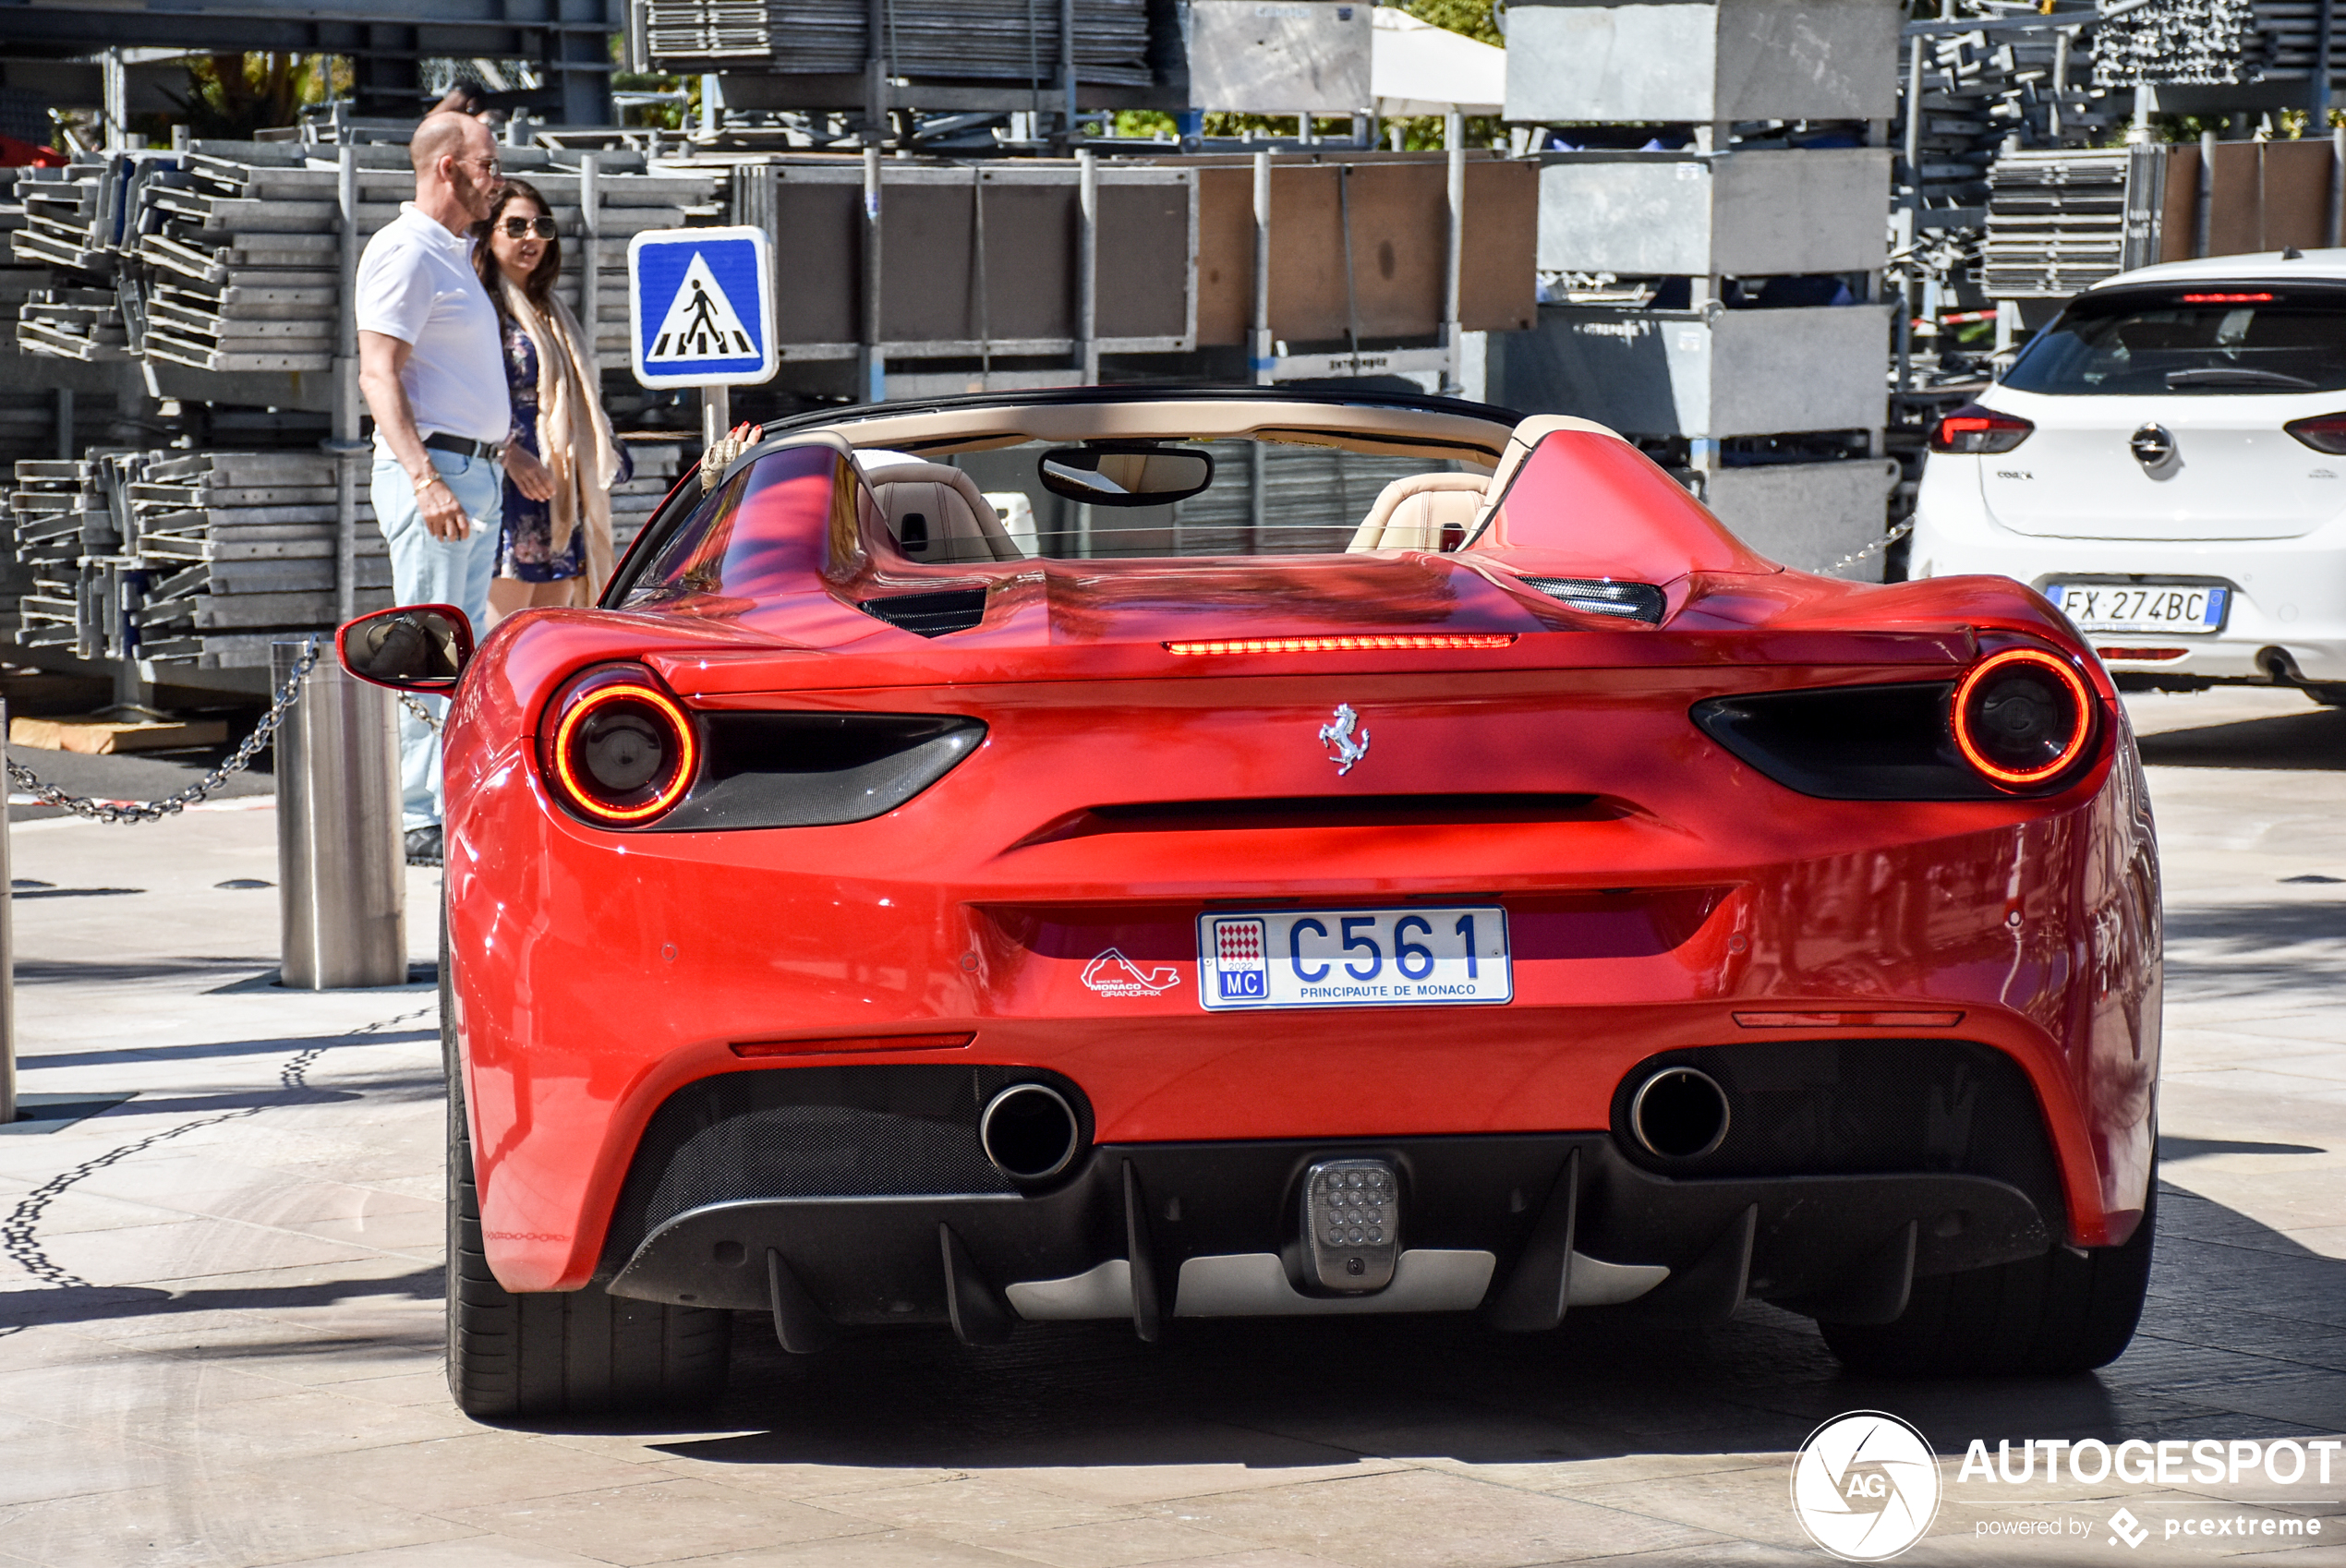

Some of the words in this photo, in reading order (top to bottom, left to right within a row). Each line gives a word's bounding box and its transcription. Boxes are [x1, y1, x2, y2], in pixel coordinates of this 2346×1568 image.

[1289, 914, 1479, 983] C561
[1228, 962, 1253, 971] 2022
[1227, 974, 1258, 995] MC
[1300, 985, 1387, 998] PRINCIPAUTE
[1394, 985, 1411, 996] DE
[1417, 983, 1476, 995] MONACO
